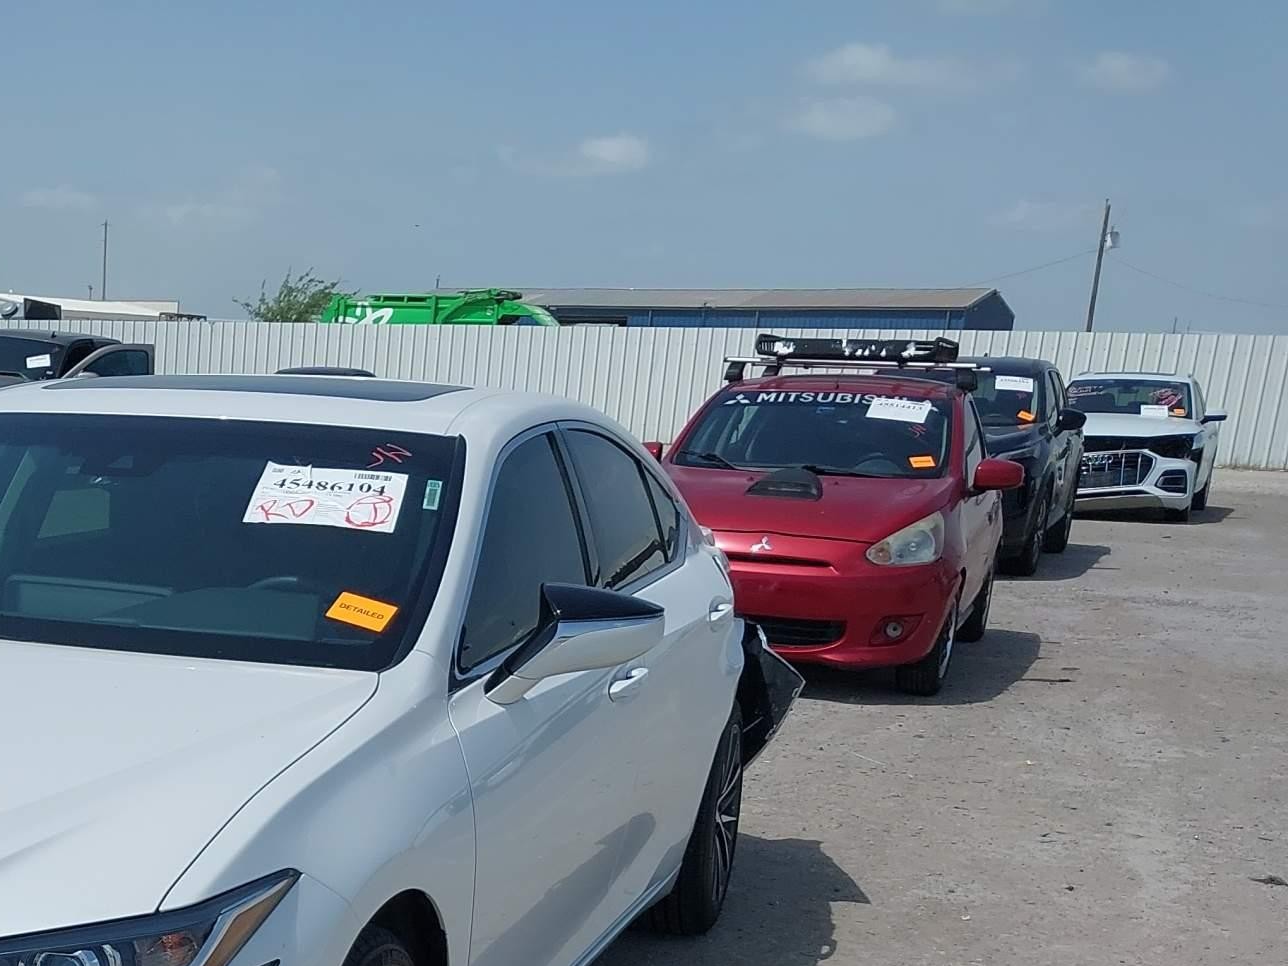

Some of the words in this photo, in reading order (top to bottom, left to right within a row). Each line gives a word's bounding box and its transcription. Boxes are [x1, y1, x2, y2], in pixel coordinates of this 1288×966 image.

[756, 392, 908, 406] MITSUBIS
[273, 477, 386, 497] 45486104
[339, 602, 385, 620] DETAILED
